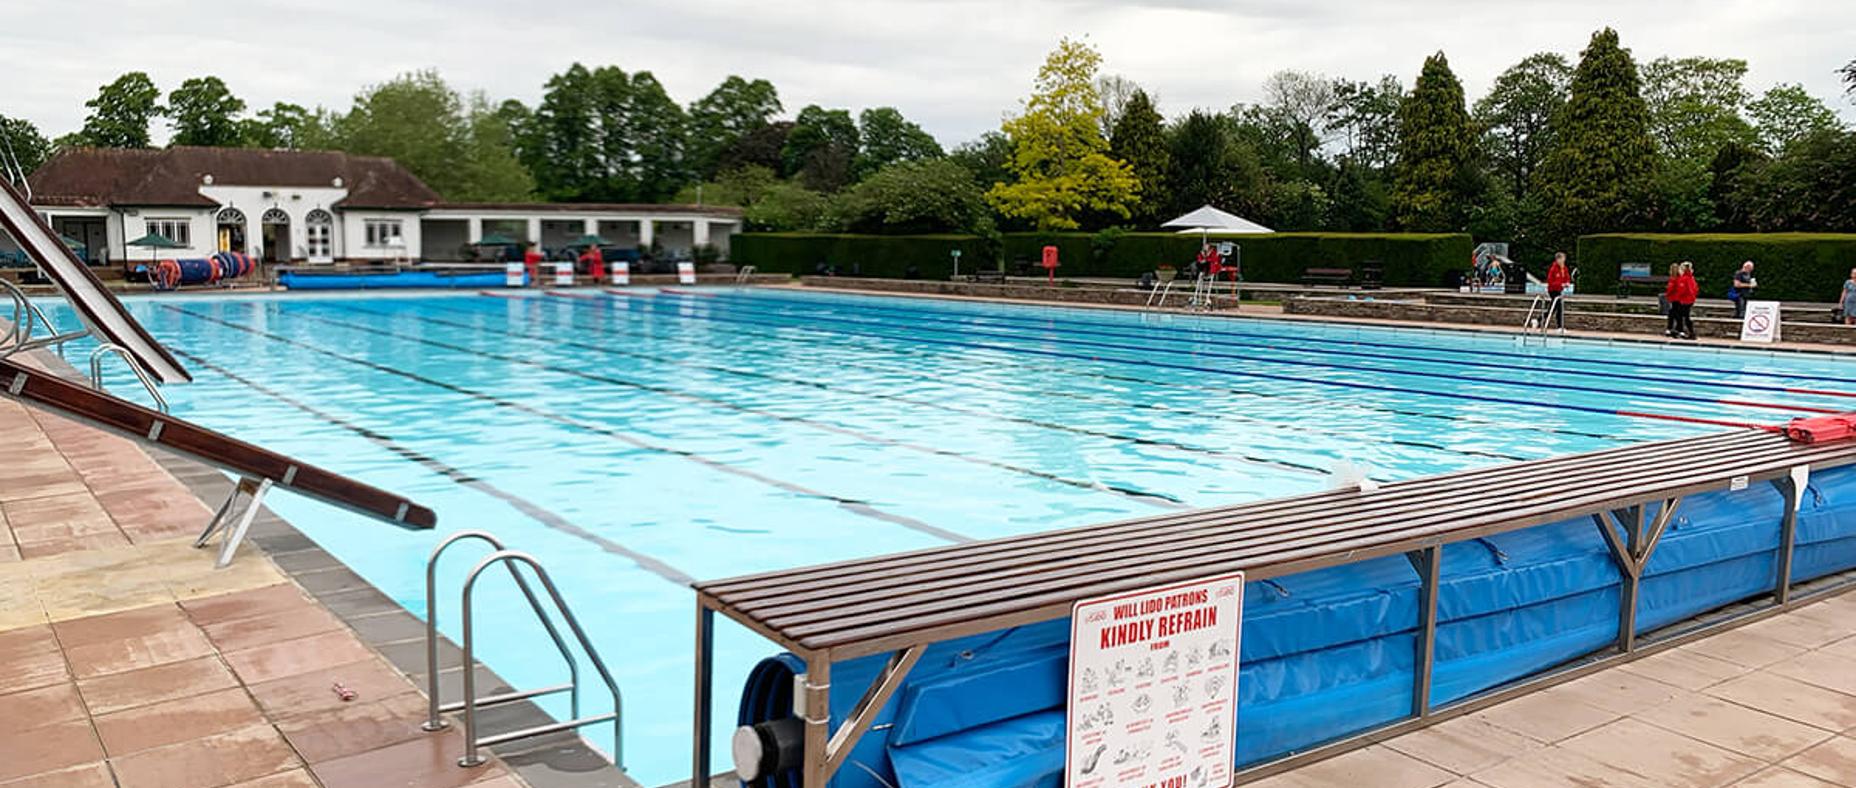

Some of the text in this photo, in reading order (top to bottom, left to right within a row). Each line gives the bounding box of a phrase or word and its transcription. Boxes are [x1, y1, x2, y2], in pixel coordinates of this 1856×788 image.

[1113, 602, 1139, 621] WILL
[1140, 599, 1163, 615] LIDO
[1164, 589, 1208, 611] PATRONS
[1100, 617, 1155, 650] KINDLY
[1158, 606, 1218, 637] REFRAIN
[1150, 641, 1170, 651] FROM
